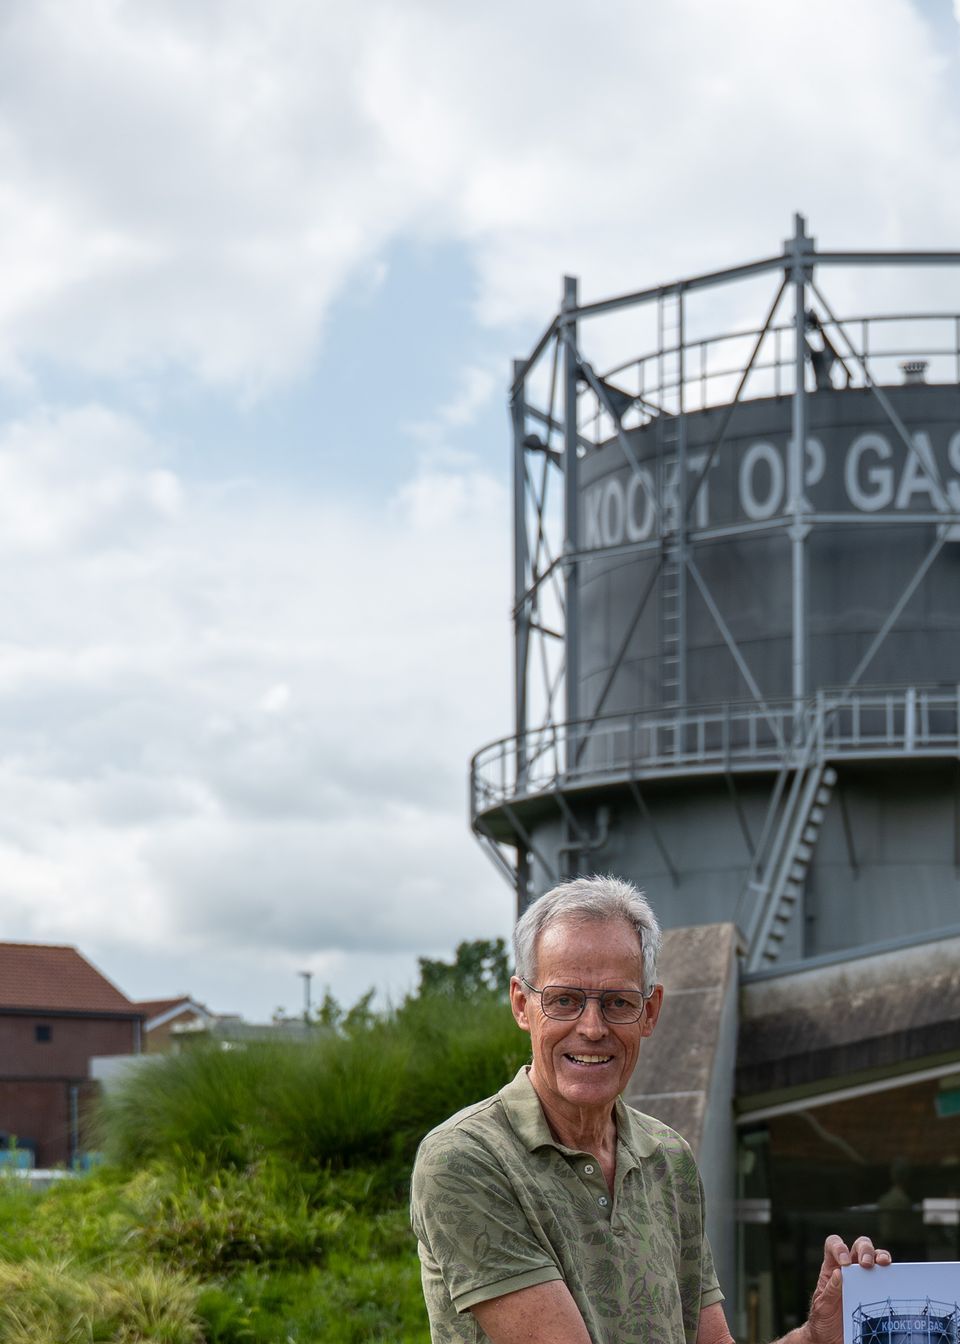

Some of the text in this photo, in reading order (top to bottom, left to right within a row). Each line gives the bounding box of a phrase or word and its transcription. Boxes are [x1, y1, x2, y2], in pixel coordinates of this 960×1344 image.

[739, 437, 826, 520] OP
[914, 1320, 927, 1330] OP
[928, 1321, 944, 1331] GAS
